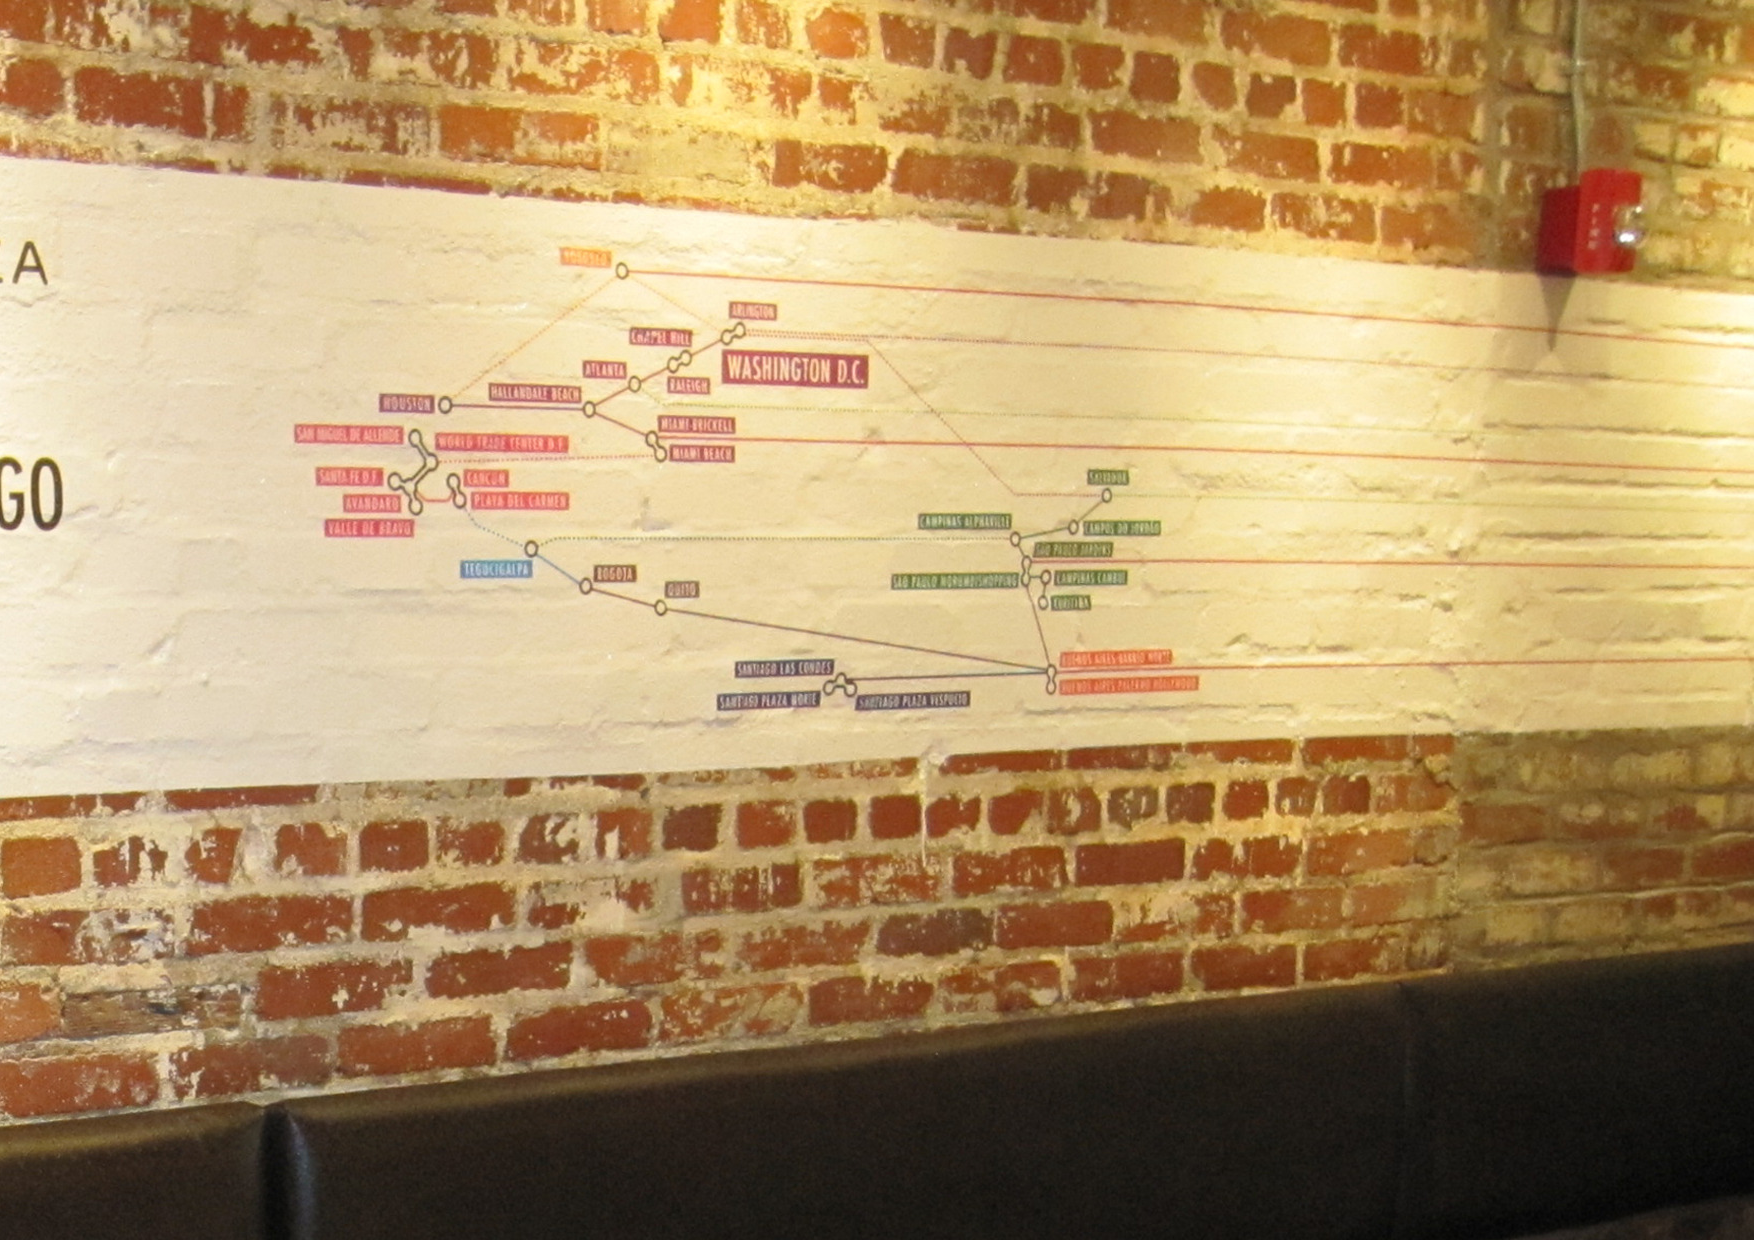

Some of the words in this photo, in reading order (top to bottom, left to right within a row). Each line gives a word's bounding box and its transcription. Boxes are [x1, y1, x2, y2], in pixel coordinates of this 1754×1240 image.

[731, 304, 775, 319] ARLINGTON
[630, 330, 667, 345] CHAPEL
[671, 332, 691, 346] HILL
[585, 363, 625, 378] ATLANTA
[727, 353, 831, 384] WASHINGTON
[837, 357, 865, 385] D.C.
[490, 385, 547, 400] HALLANDALE
[551, 387, 579, 401] BEACH
[669, 379, 709, 394] RALEIGH
[383, 396, 432, 411] HOUSTON
[297, 427, 314, 442] SAN
[316, 427, 347, 442] MIGUEL
[351, 428, 363, 443] DE
[363, 428, 400, 443] ALLENDE
[438, 435, 474, 450] WORLD
[477, 435, 506, 451] TRADE
[509, 436, 545, 451] CENTER
[673, 447, 701, 461] MIAMI
[704, 448, 733, 462] BEACH
[318, 469, 349, 485] SANTA
[474, 494, 504, 508] PLAYA
[508, 494, 527, 509] DEL
[530, 494, 567, 509] CARMEN
[328, 522, 358, 537] VALLE
[362, 521, 376, 536] DE
[379, 521, 412, 536] BRAVO
[463, 562, 529, 577] TEGUCIGALPA
[736, 661, 777, 677] SANTIAGO
[779, 661, 796, 676] LAS
[799, 660, 832, 675] CONDES
[719, 694, 758, 710] SANTIAGO
[761, 693, 788, 708] PLAZA
[902, 693, 928, 709] PLAZA
